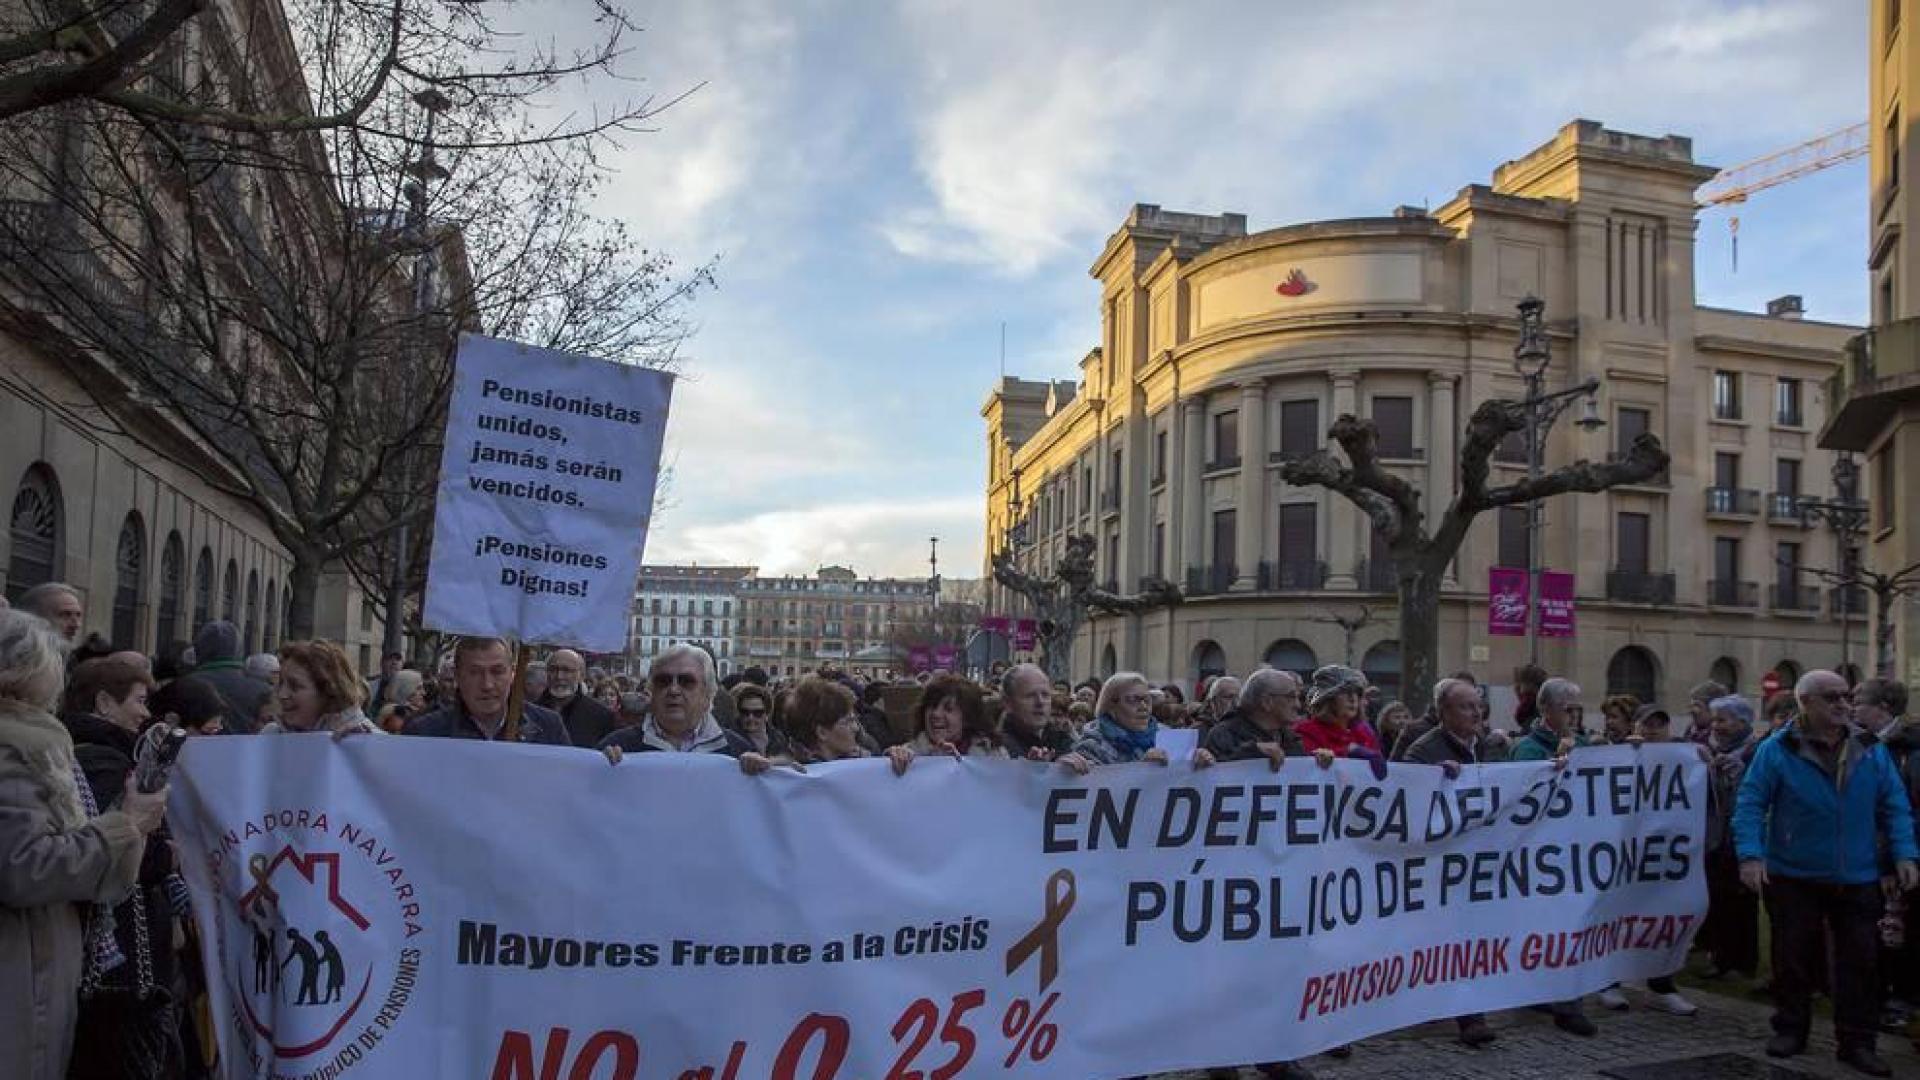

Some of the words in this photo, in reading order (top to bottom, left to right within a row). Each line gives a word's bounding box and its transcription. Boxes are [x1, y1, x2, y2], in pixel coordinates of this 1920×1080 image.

[482, 379, 642, 424] Pensionistas
[478, 415, 568, 444] unidos,
[470, 441, 549, 470] jamás
[555, 461, 622, 483] serán
[468, 475, 584, 507] vencidos.
[475, 535, 607, 570] ¡Pensiones
[501, 567, 588, 598] Dignas!
[1043, 788, 1141, 853] EN
[1155, 784, 1408, 848] DEFENSA
[1510, 763, 1691, 825] SISTEMA
[339, 822, 423, 938] NAVARRA
[1125, 858, 1363, 947] PÚBLICO
[1374, 856, 1426, 918] DE
[1439, 835, 1691, 906] PENSIONES
[457, 919, 660, 970] Mayores
[671, 939, 812, 967] Frente
[820, 939, 845, 964] a
[852, 931, 885, 961] la
[893, 915, 990, 956] Crisis
[358, 1024, 383, 1050] DE
[374, 947, 421, 1029] PENSIONES
[1299, 955, 1405, 1021] PENTSIO
[1407, 937, 1511, 989] DUINAK
[1002, 992, 1061, 1069] %
